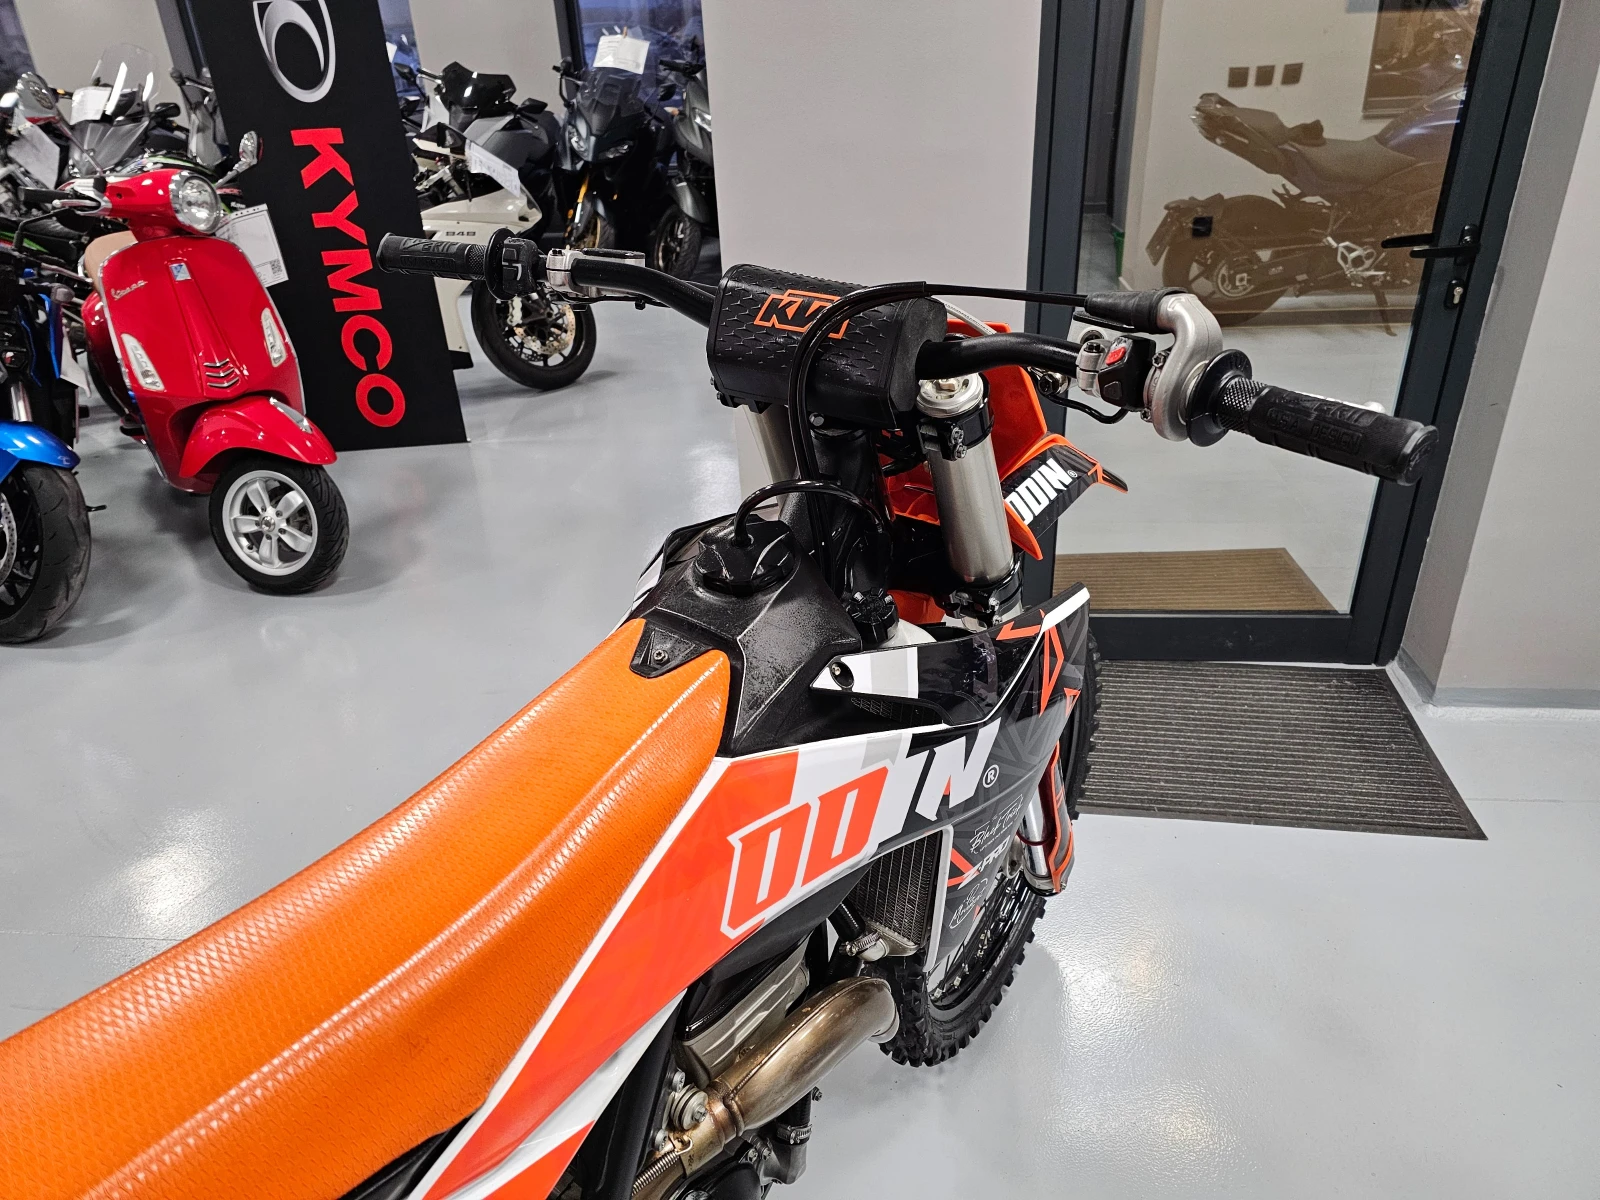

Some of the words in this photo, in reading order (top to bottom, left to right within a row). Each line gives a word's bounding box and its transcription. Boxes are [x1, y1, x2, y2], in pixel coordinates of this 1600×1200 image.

[110, 279, 149, 301] Vespa
[291, 127, 406, 428] KYMCO
[753, 289, 850, 340] KT
